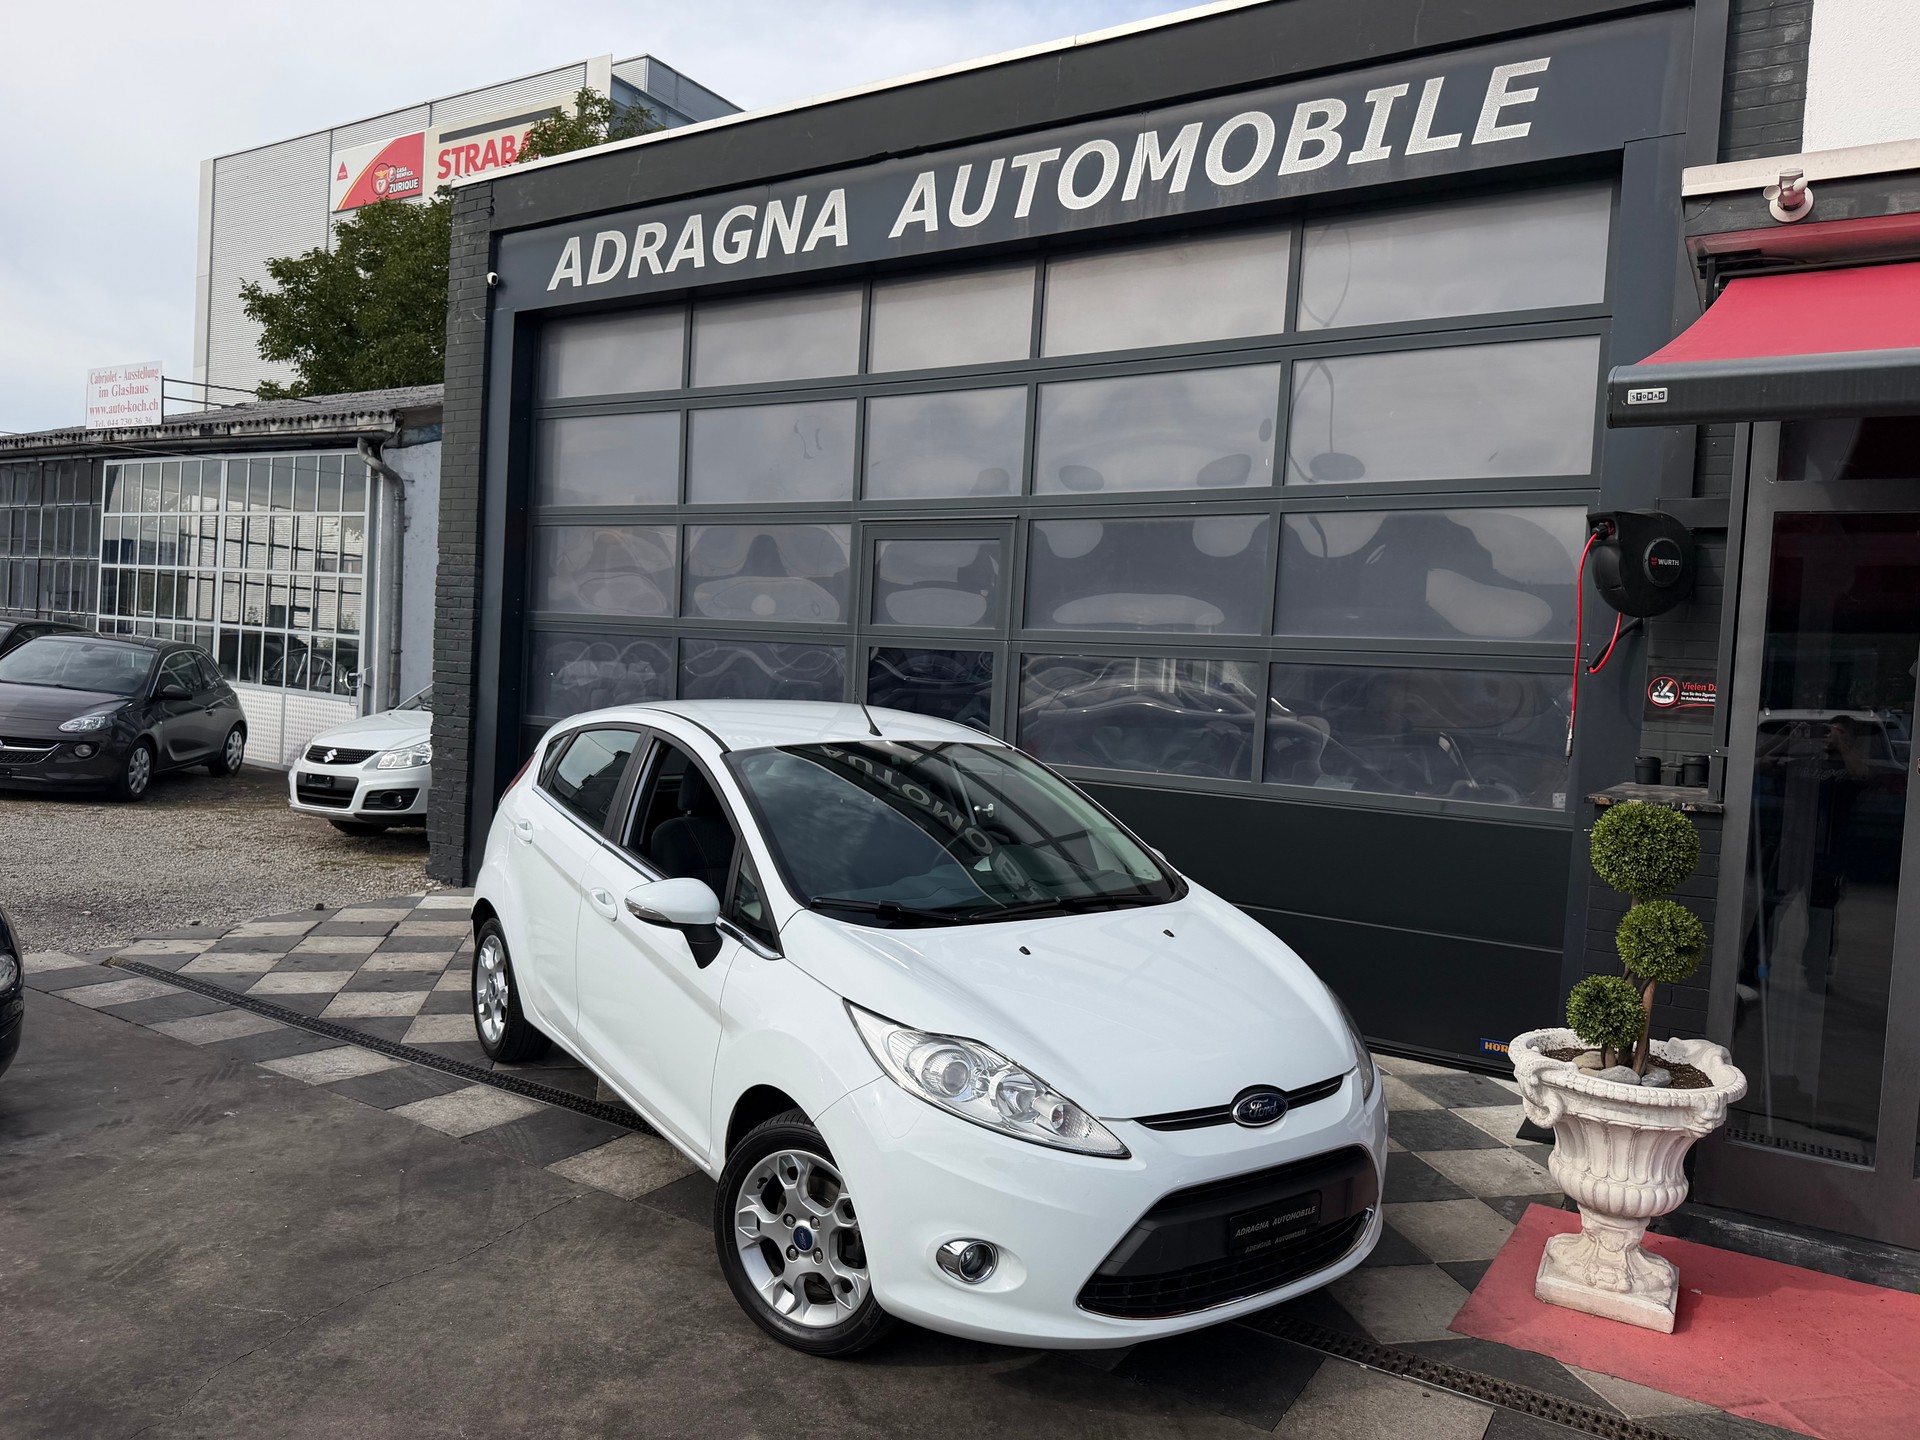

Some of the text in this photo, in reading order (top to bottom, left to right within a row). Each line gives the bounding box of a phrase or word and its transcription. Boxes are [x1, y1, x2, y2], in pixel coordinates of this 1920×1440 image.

[546, 56, 1551, 292] ADRAGNA AUTOMOBILE
[389, 178, 419, 194] ZURIQUE
[90, 370, 117, 385] Cabriolet
[123, 366, 159, 381] Ausstellung
[98, 383, 149, 398] im Glashaus
[89, 398, 159, 416] www.auto-koch.ch
[94, 416, 153, 428] Tel. 044 730 36 36
[1682, 681, 1706, 691] Vielen
[1248, 1098, 1278, 1118] Ford
[1235, 1205, 1317, 1238] ADRAGNA AUTOMOBILE
